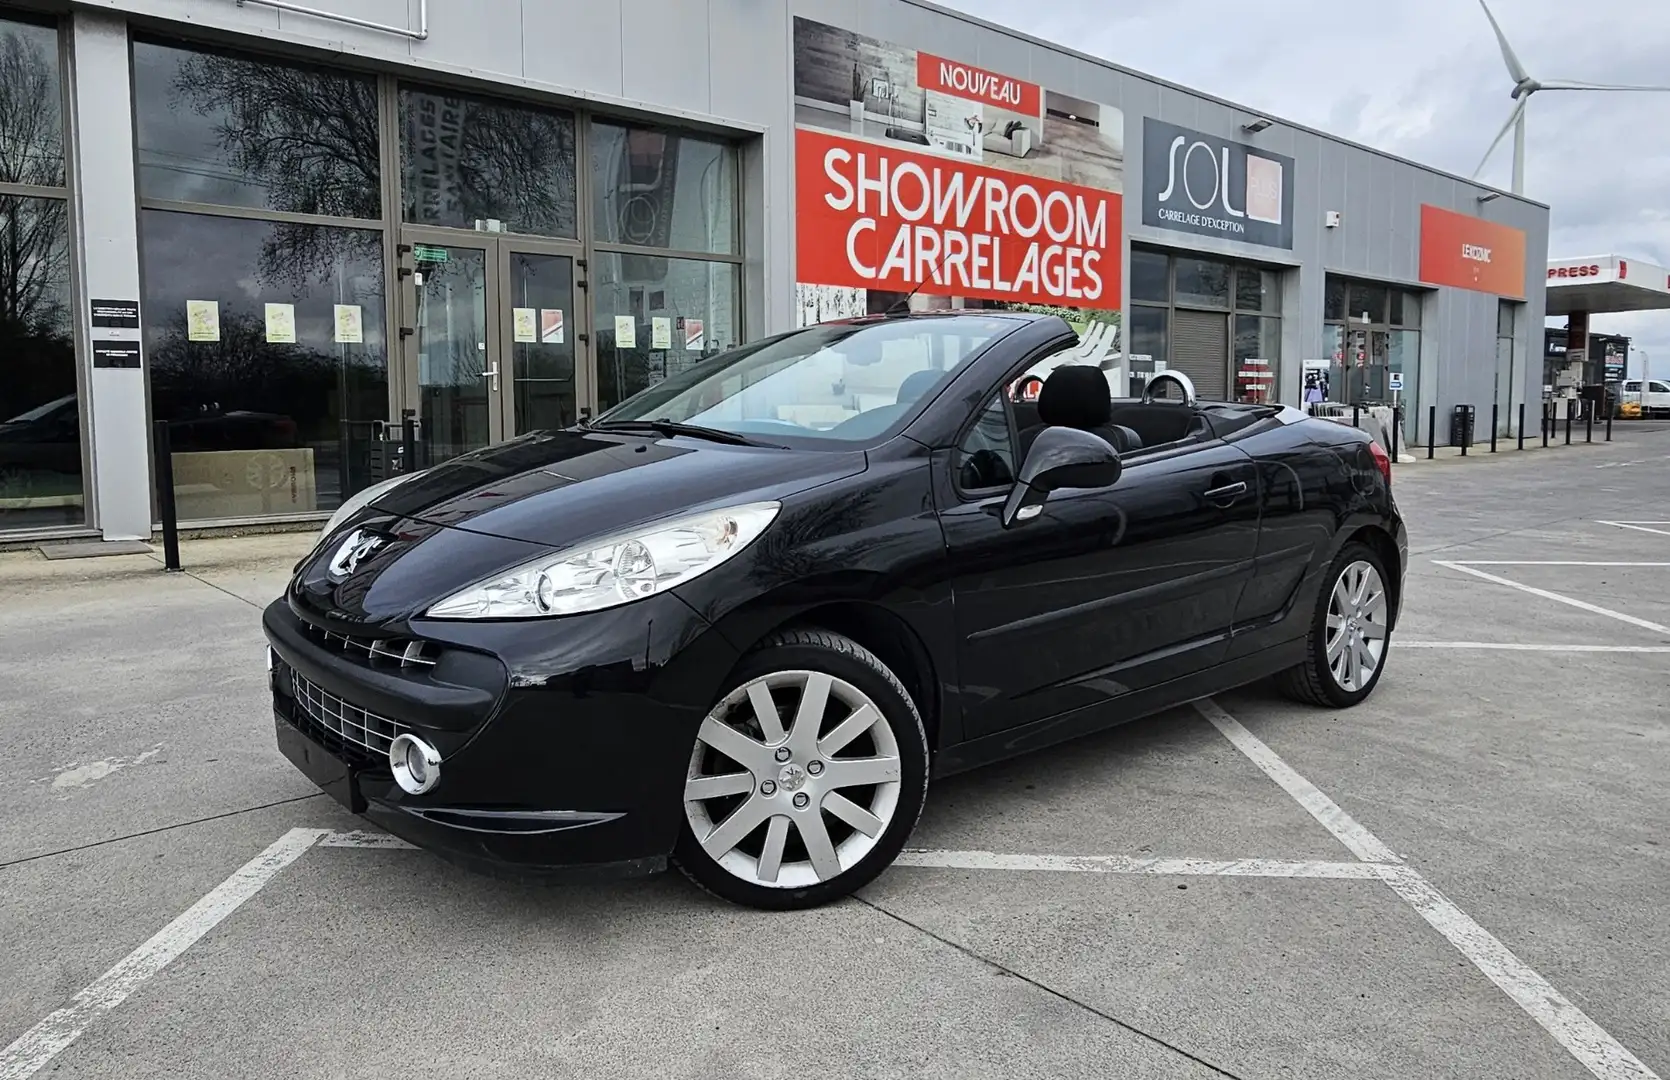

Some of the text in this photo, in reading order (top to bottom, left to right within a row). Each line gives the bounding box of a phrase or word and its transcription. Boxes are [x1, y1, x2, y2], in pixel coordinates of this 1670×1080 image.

[940, 62, 1020, 105] NOUVEAU
[824, 148, 1106, 249] SHOWROOM
[1158, 136, 1244, 217] SOL
[1158, 208, 1245, 234] CARRELAGE D'EXCEPTION
[846, 217, 1103, 300] CARRELAGES
[1547, 264, 1600, 279] PRESS
